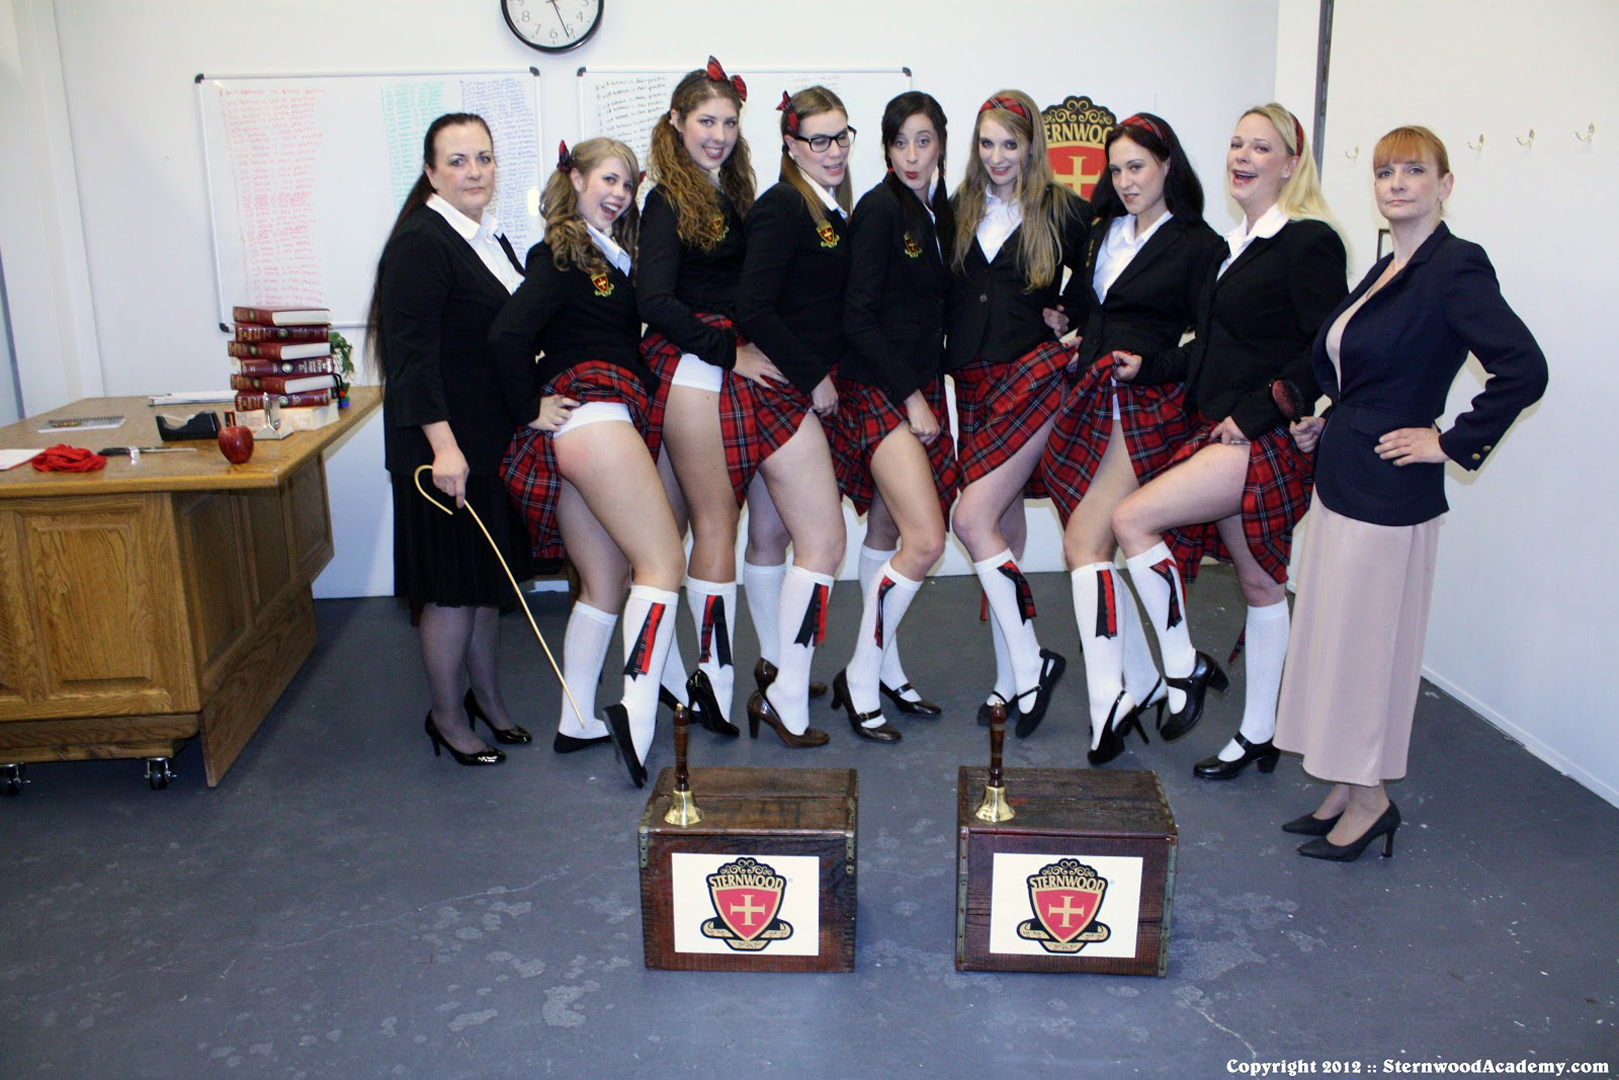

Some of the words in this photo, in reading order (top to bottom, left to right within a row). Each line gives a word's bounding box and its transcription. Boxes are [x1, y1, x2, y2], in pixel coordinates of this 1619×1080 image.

[521, 10, 530, 22] 8
[576, 11, 583, 22] 4
[534, 23, 542, 35] 7
[549, 28, 559, 39] 6
[566, 24, 574, 35] 5
[708, 874, 784, 890] STERNWOOD
[1029, 875, 1106, 892] STERNWOOD
